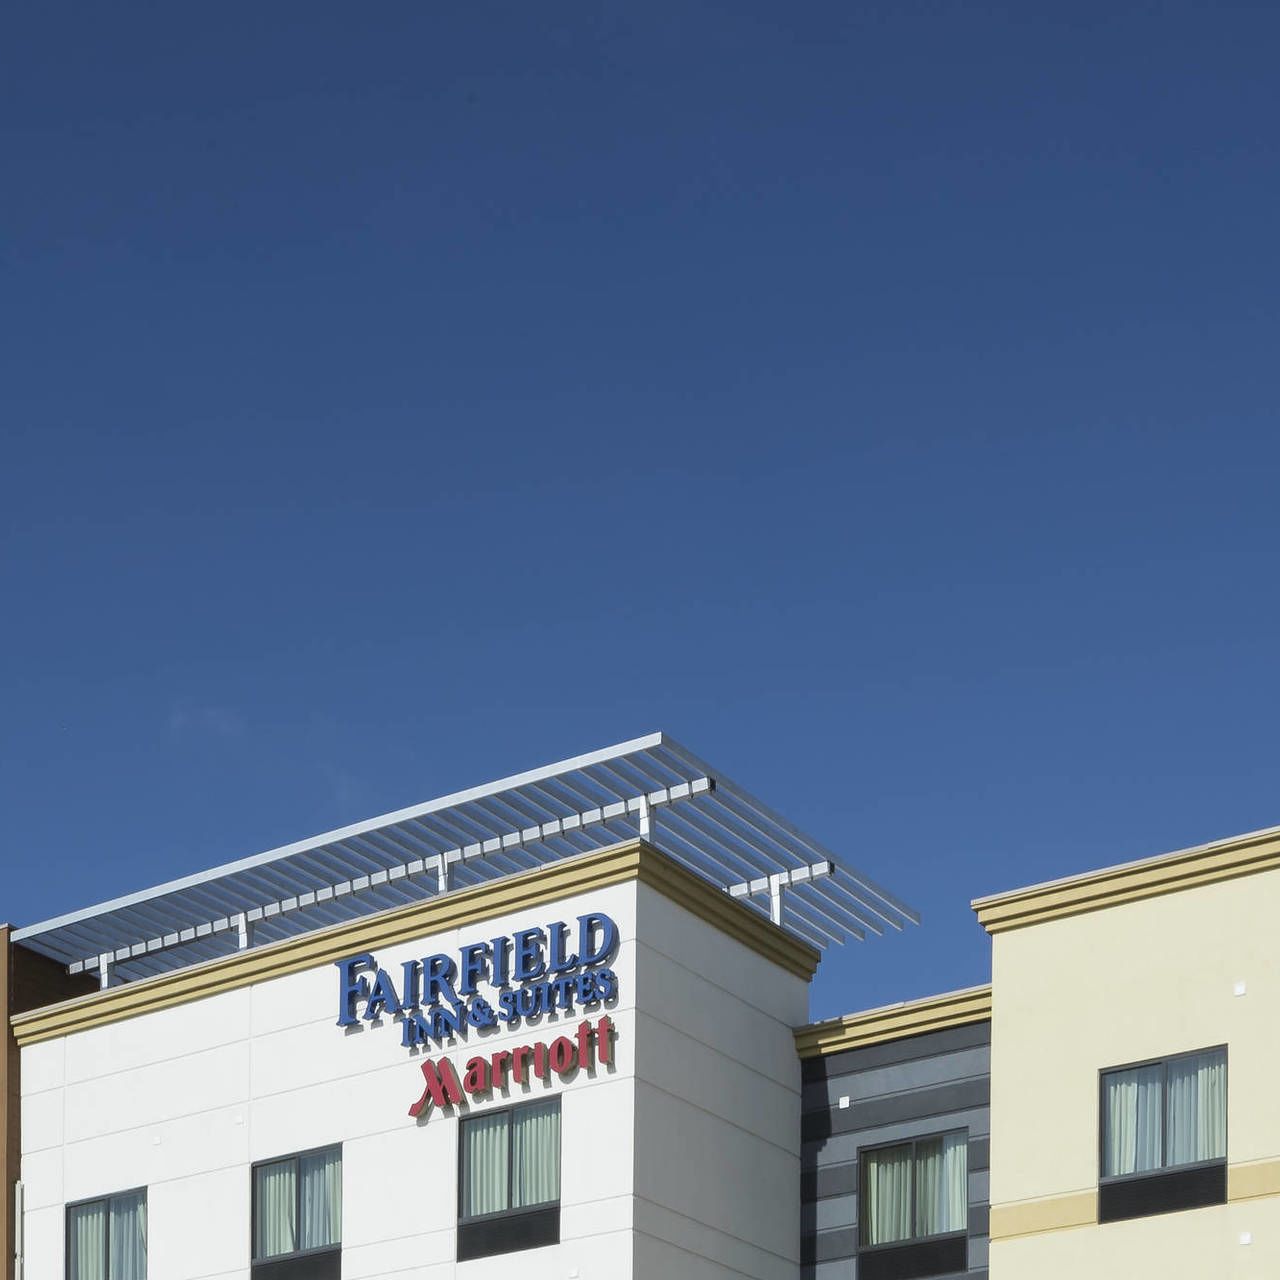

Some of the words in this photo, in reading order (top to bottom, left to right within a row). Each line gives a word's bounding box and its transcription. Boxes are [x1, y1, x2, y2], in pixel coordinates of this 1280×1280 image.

[334, 912, 619, 1027] FAIRFIELD
[401, 1001, 468, 1047] INN
[470, 995, 498, 1028] &
[498, 968, 618, 1021] SUITES
[408, 1015, 616, 1118] Marriott
